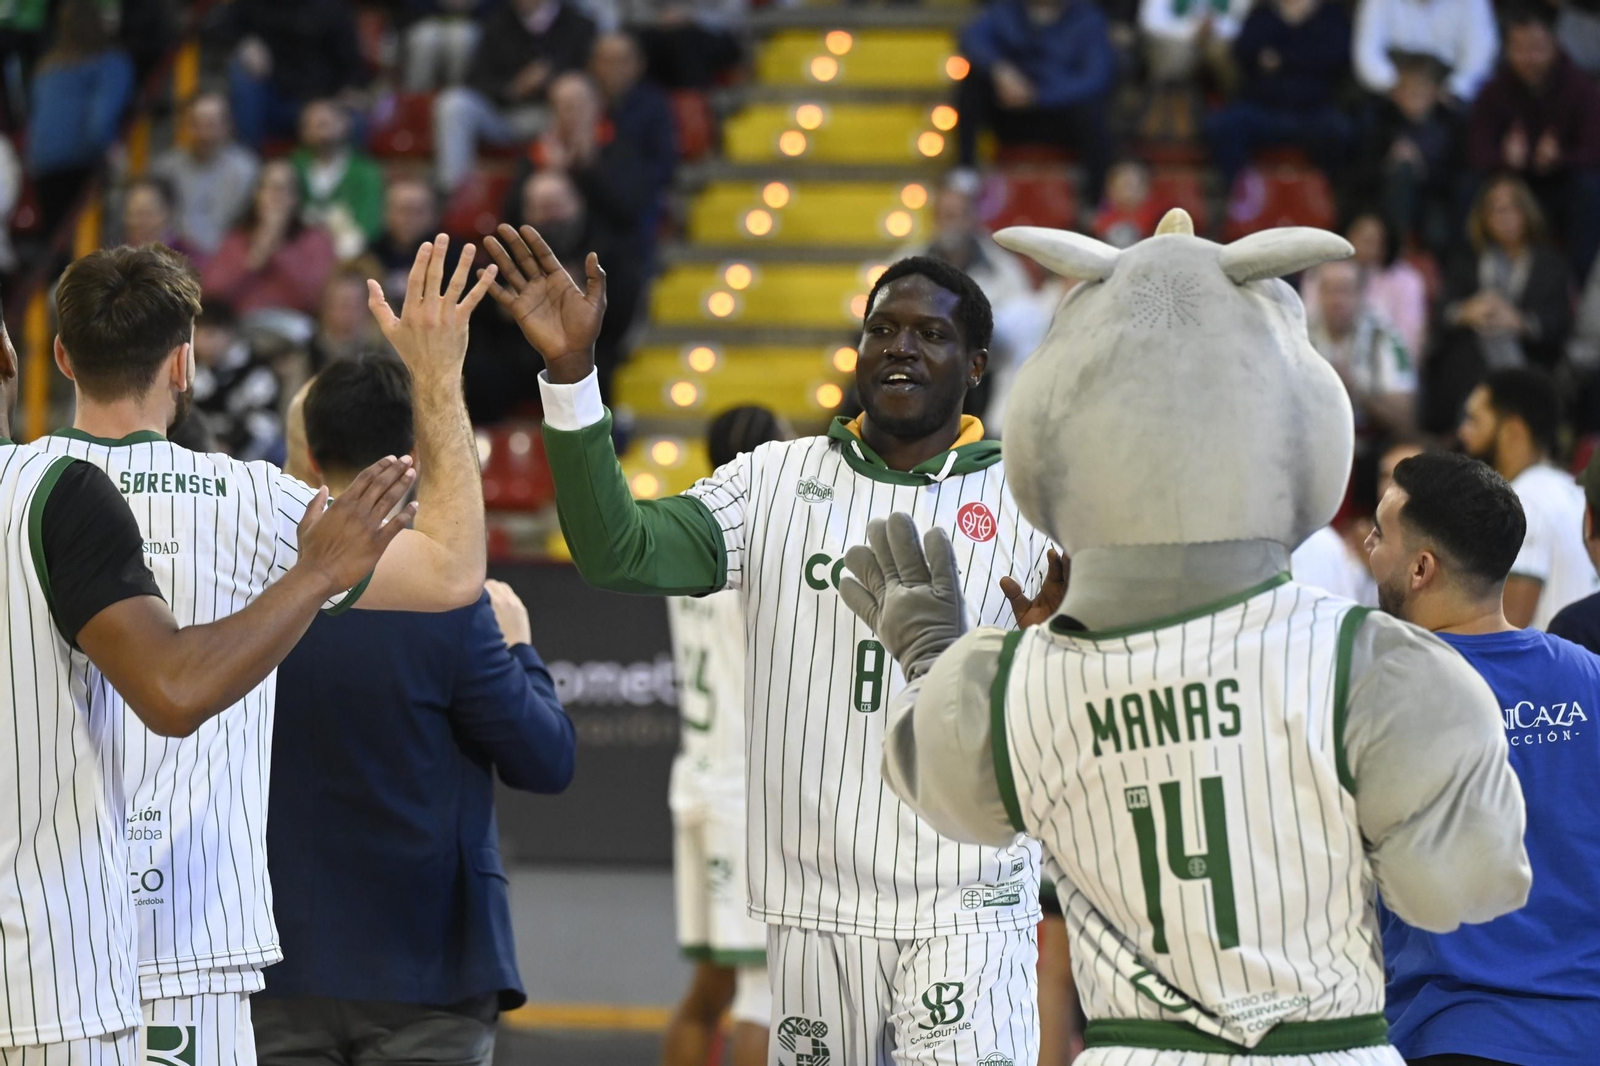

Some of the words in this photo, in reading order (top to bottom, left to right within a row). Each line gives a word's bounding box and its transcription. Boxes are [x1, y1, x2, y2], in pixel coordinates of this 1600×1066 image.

[120, 471, 227, 497] SØRENSEN
[854, 639, 885, 713] 8
[1086, 679, 1241, 757] MANAS
[1124, 776, 1240, 954] 14
